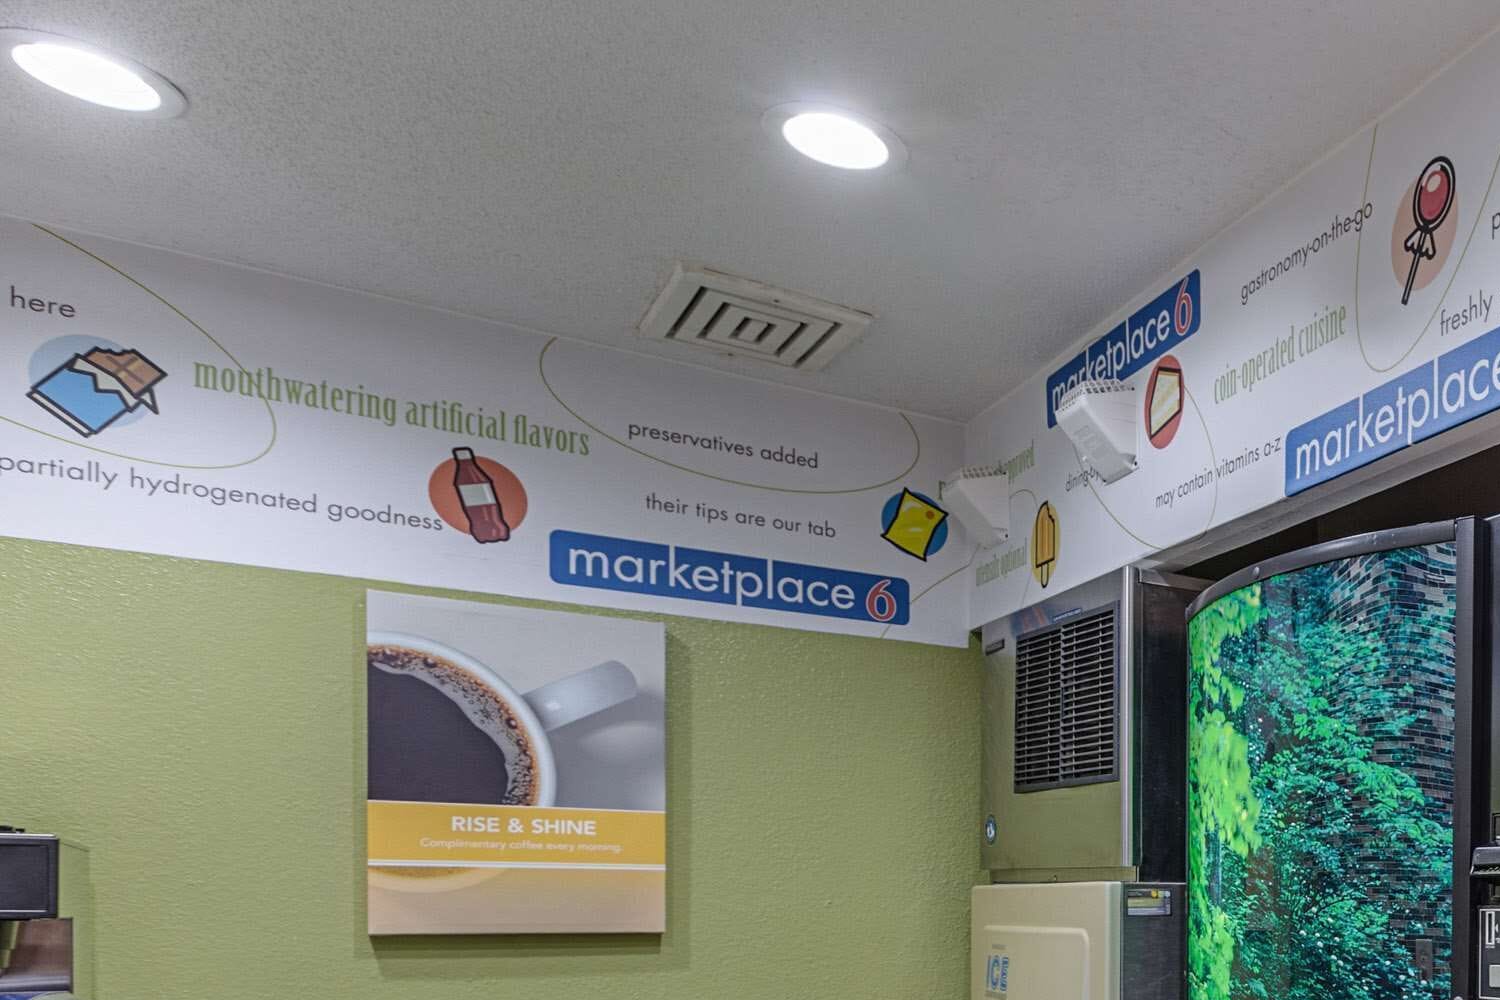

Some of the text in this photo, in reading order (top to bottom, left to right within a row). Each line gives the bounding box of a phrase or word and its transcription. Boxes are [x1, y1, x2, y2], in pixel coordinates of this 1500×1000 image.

[1240, 203, 1373, 305] gastronomy-on-the-go
[9, 285, 76, 318] here
[1175, 278, 1192, 336] 6
[1439, 292, 1493, 338] freshly
[1214, 303, 1347, 405] coin-operated cuisine
[194, 360, 590, 457] mouthwatering artificial flavors
[628, 420, 819, 469] preservatives added
[1155, 437, 1281, 509] may contain vitamins a-z
[0, 457, 443, 532] partially hydrogenated goodness
[645, 493, 837, 539] their tips are our tab
[568, 544, 897, 623] marketplace 6
[452, 816, 597, 836] RISE & SHINE
[509, 839, 543, 851] coffee
